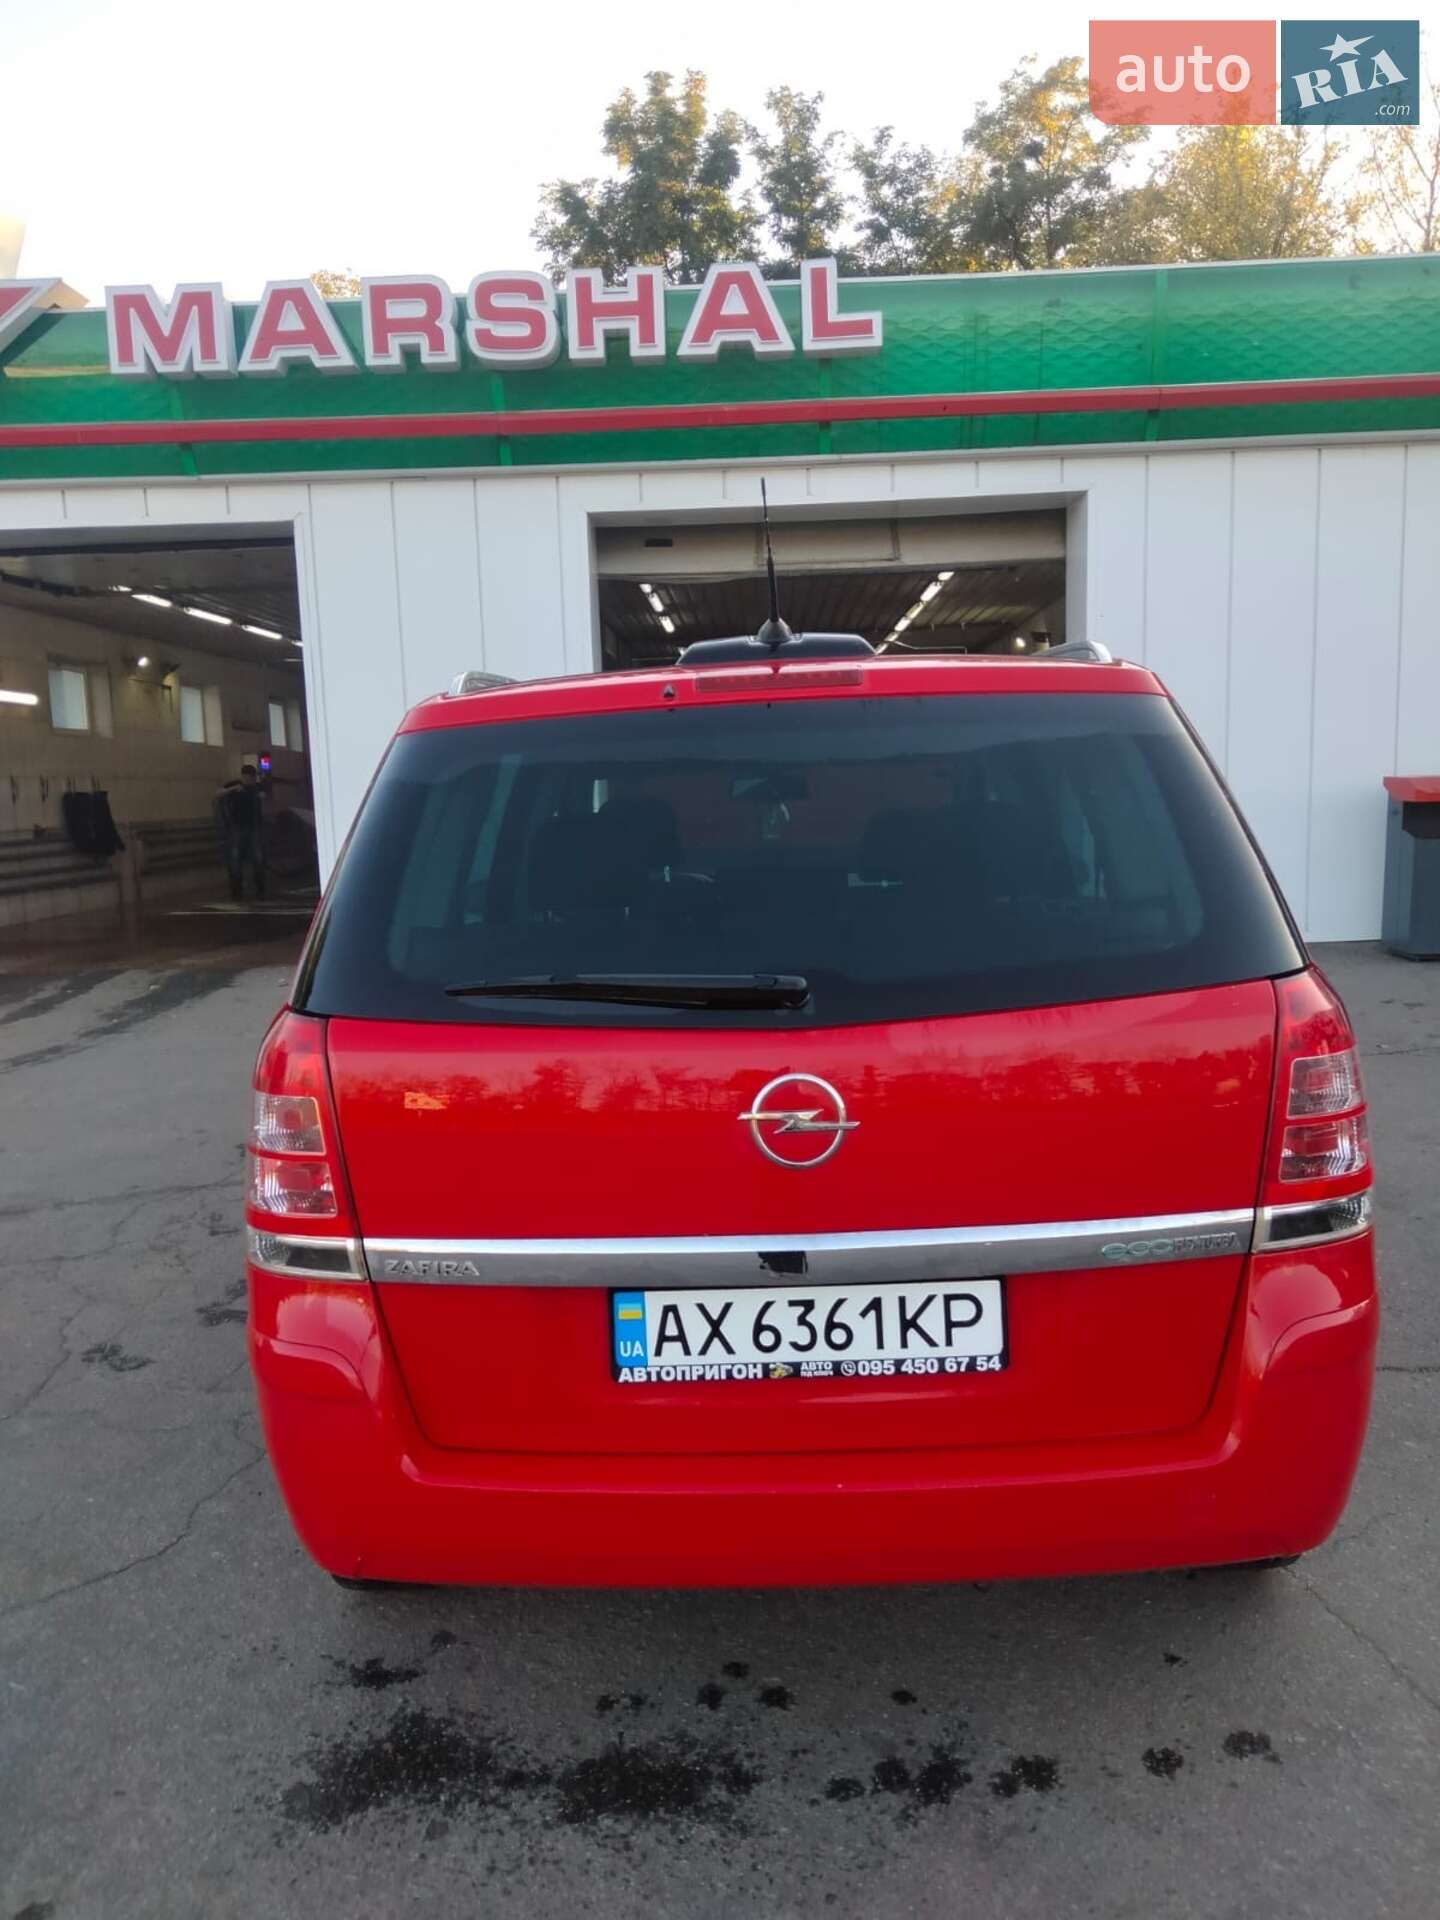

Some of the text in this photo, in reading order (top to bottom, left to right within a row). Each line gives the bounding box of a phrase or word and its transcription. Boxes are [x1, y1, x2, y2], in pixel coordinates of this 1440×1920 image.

[105, 258, 883, 377] MARSHAL
[384, 1259, 480, 1277] ZAFIRA
[620, 1341, 644, 1357] UA
[618, 1363, 763, 1383] АВТОПРИГОН
[800, 1361, 833, 1371] АВТО
[857, 1355, 1002, 1376] 095 450 67 54
